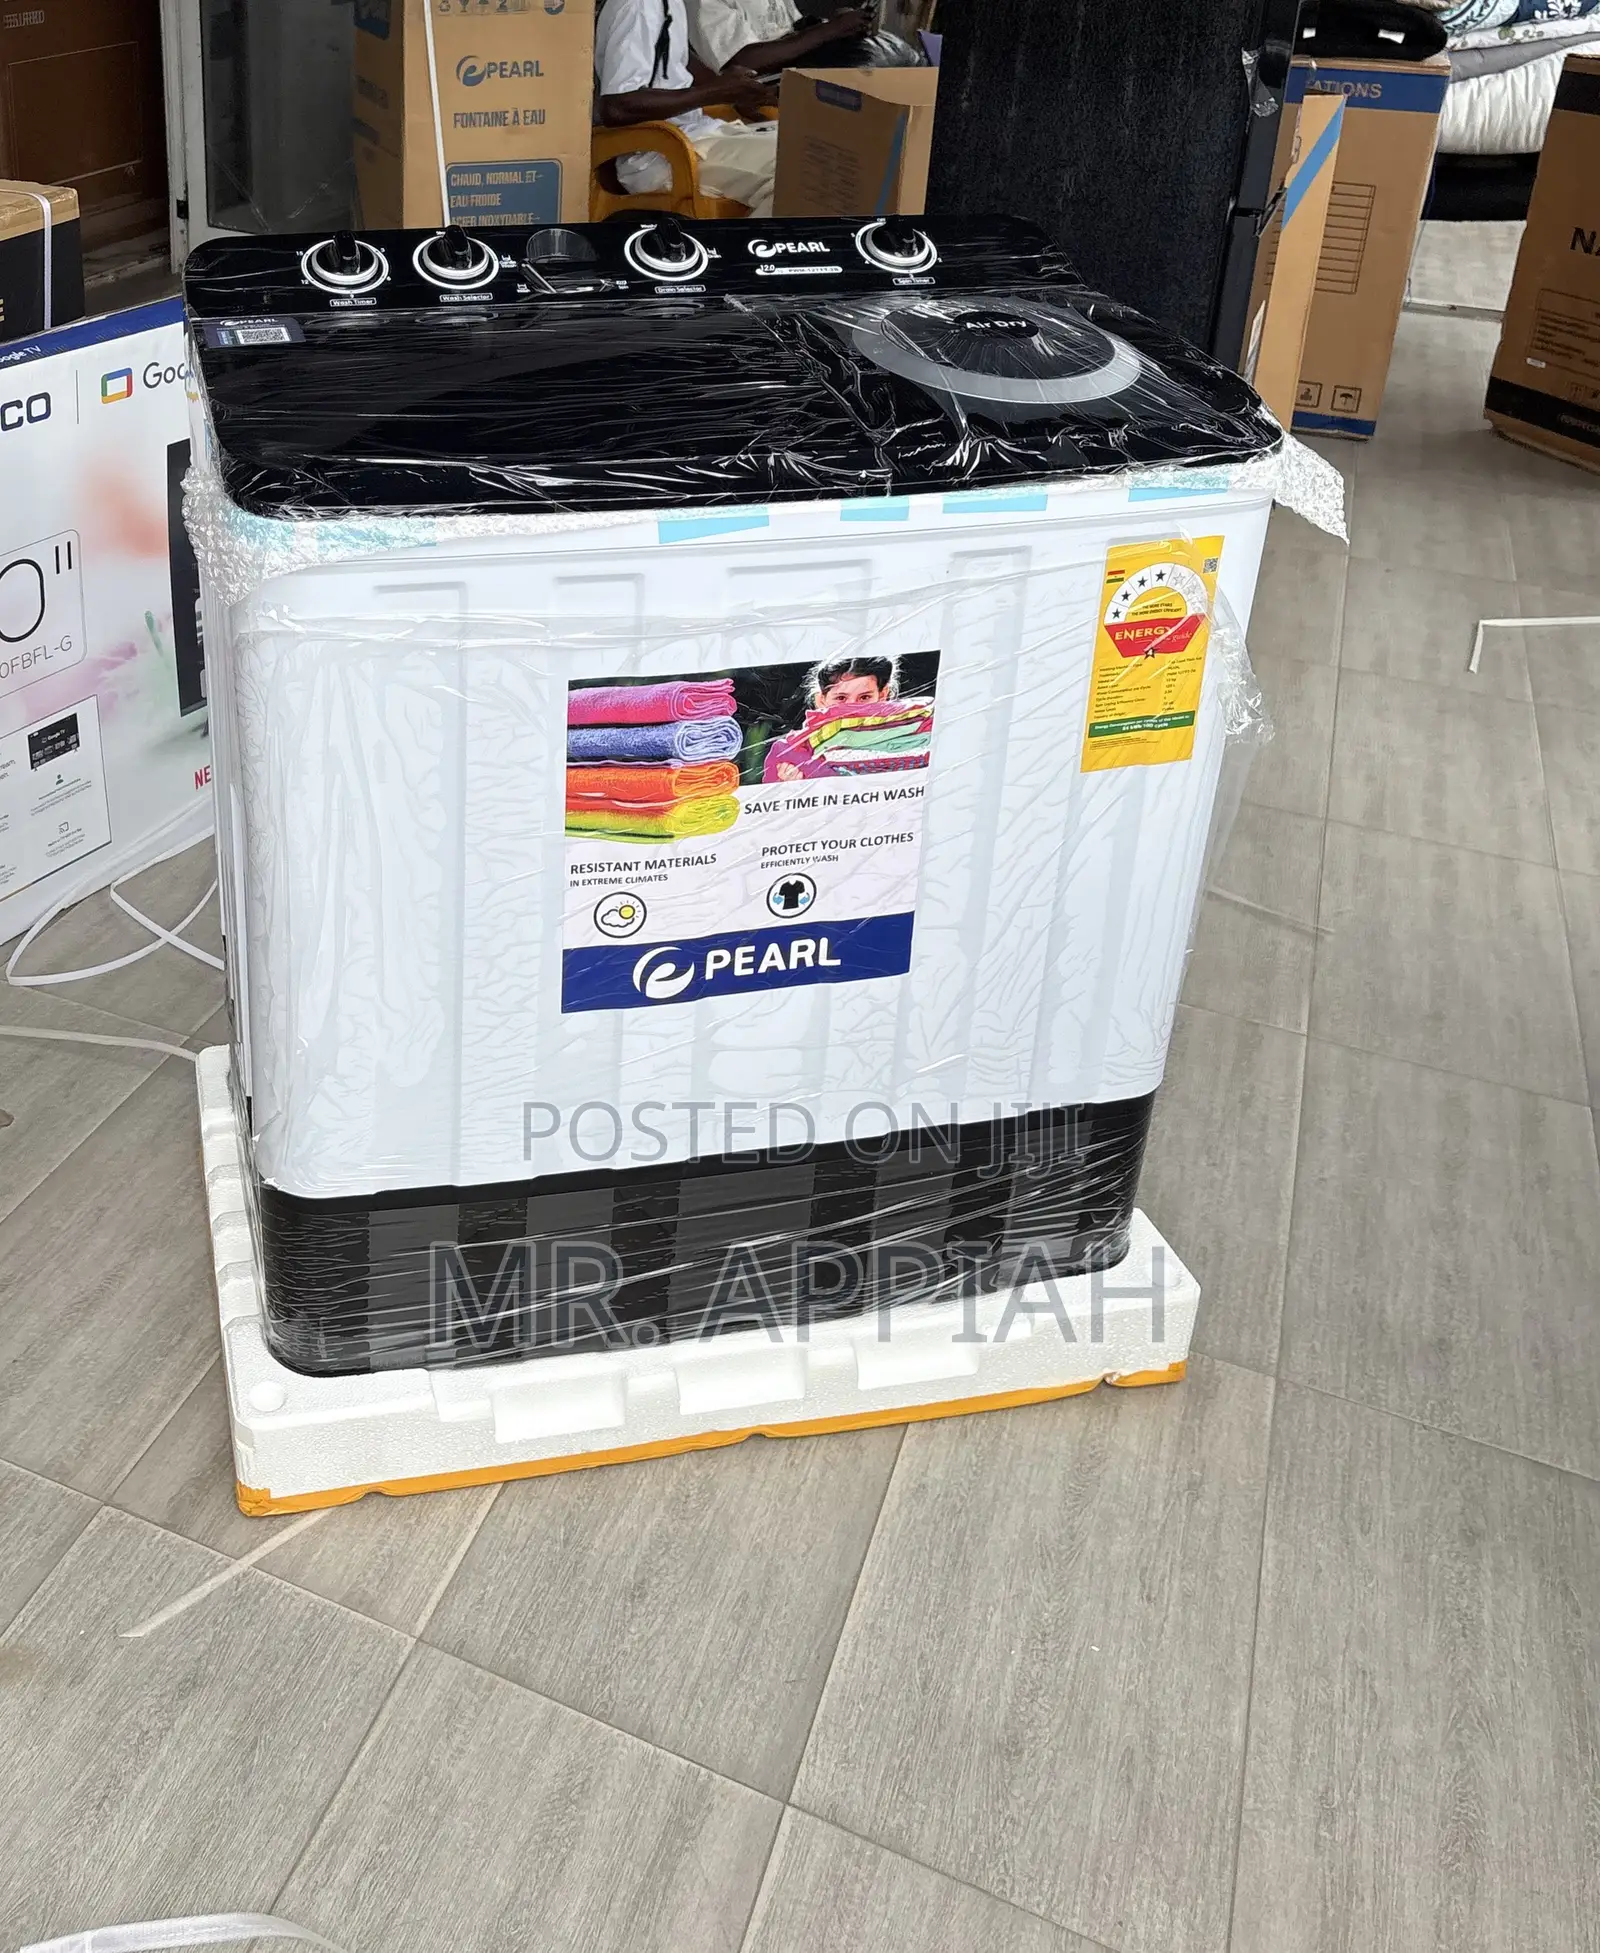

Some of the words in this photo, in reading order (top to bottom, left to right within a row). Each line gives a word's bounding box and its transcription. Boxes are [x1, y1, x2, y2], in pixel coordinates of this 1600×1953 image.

[486, 60, 544, 79] PEARL
[453, 110, 510, 129] FONTAINE
[523, 108, 546, 126] EAU
[486, 171, 524, 185] NORMAL
[774, 241, 830, 254] PEARL
[966, 320, 991, 329] Air
[994, 320, 1027, 330] Dry
[23, 345, 41, 354] TV
[744, 800, 781, 815] SAVE
[784, 796, 819, 810] TIME
[823, 794, 838, 806] IN
[843, 791, 879, 805] EACH
[883, 786, 925, 801] WASH
[761, 841, 818, 857] PROTECT
[821, 838, 857, 851] YOUR
[860, 832, 914, 847] CLOTHES
[570, 860, 641, 875] RESISTANT
[644, 853, 717, 870] MATERIALS
[760, 856, 811, 869] EFFICIENTLY
[812, 854, 839, 863] WASH
[569, 879, 580, 888] IN
[582, 877, 623, 887] EXTREME
[625, 874, 668, 884] CLIMATES
[704, 938, 842, 980] PEARL
